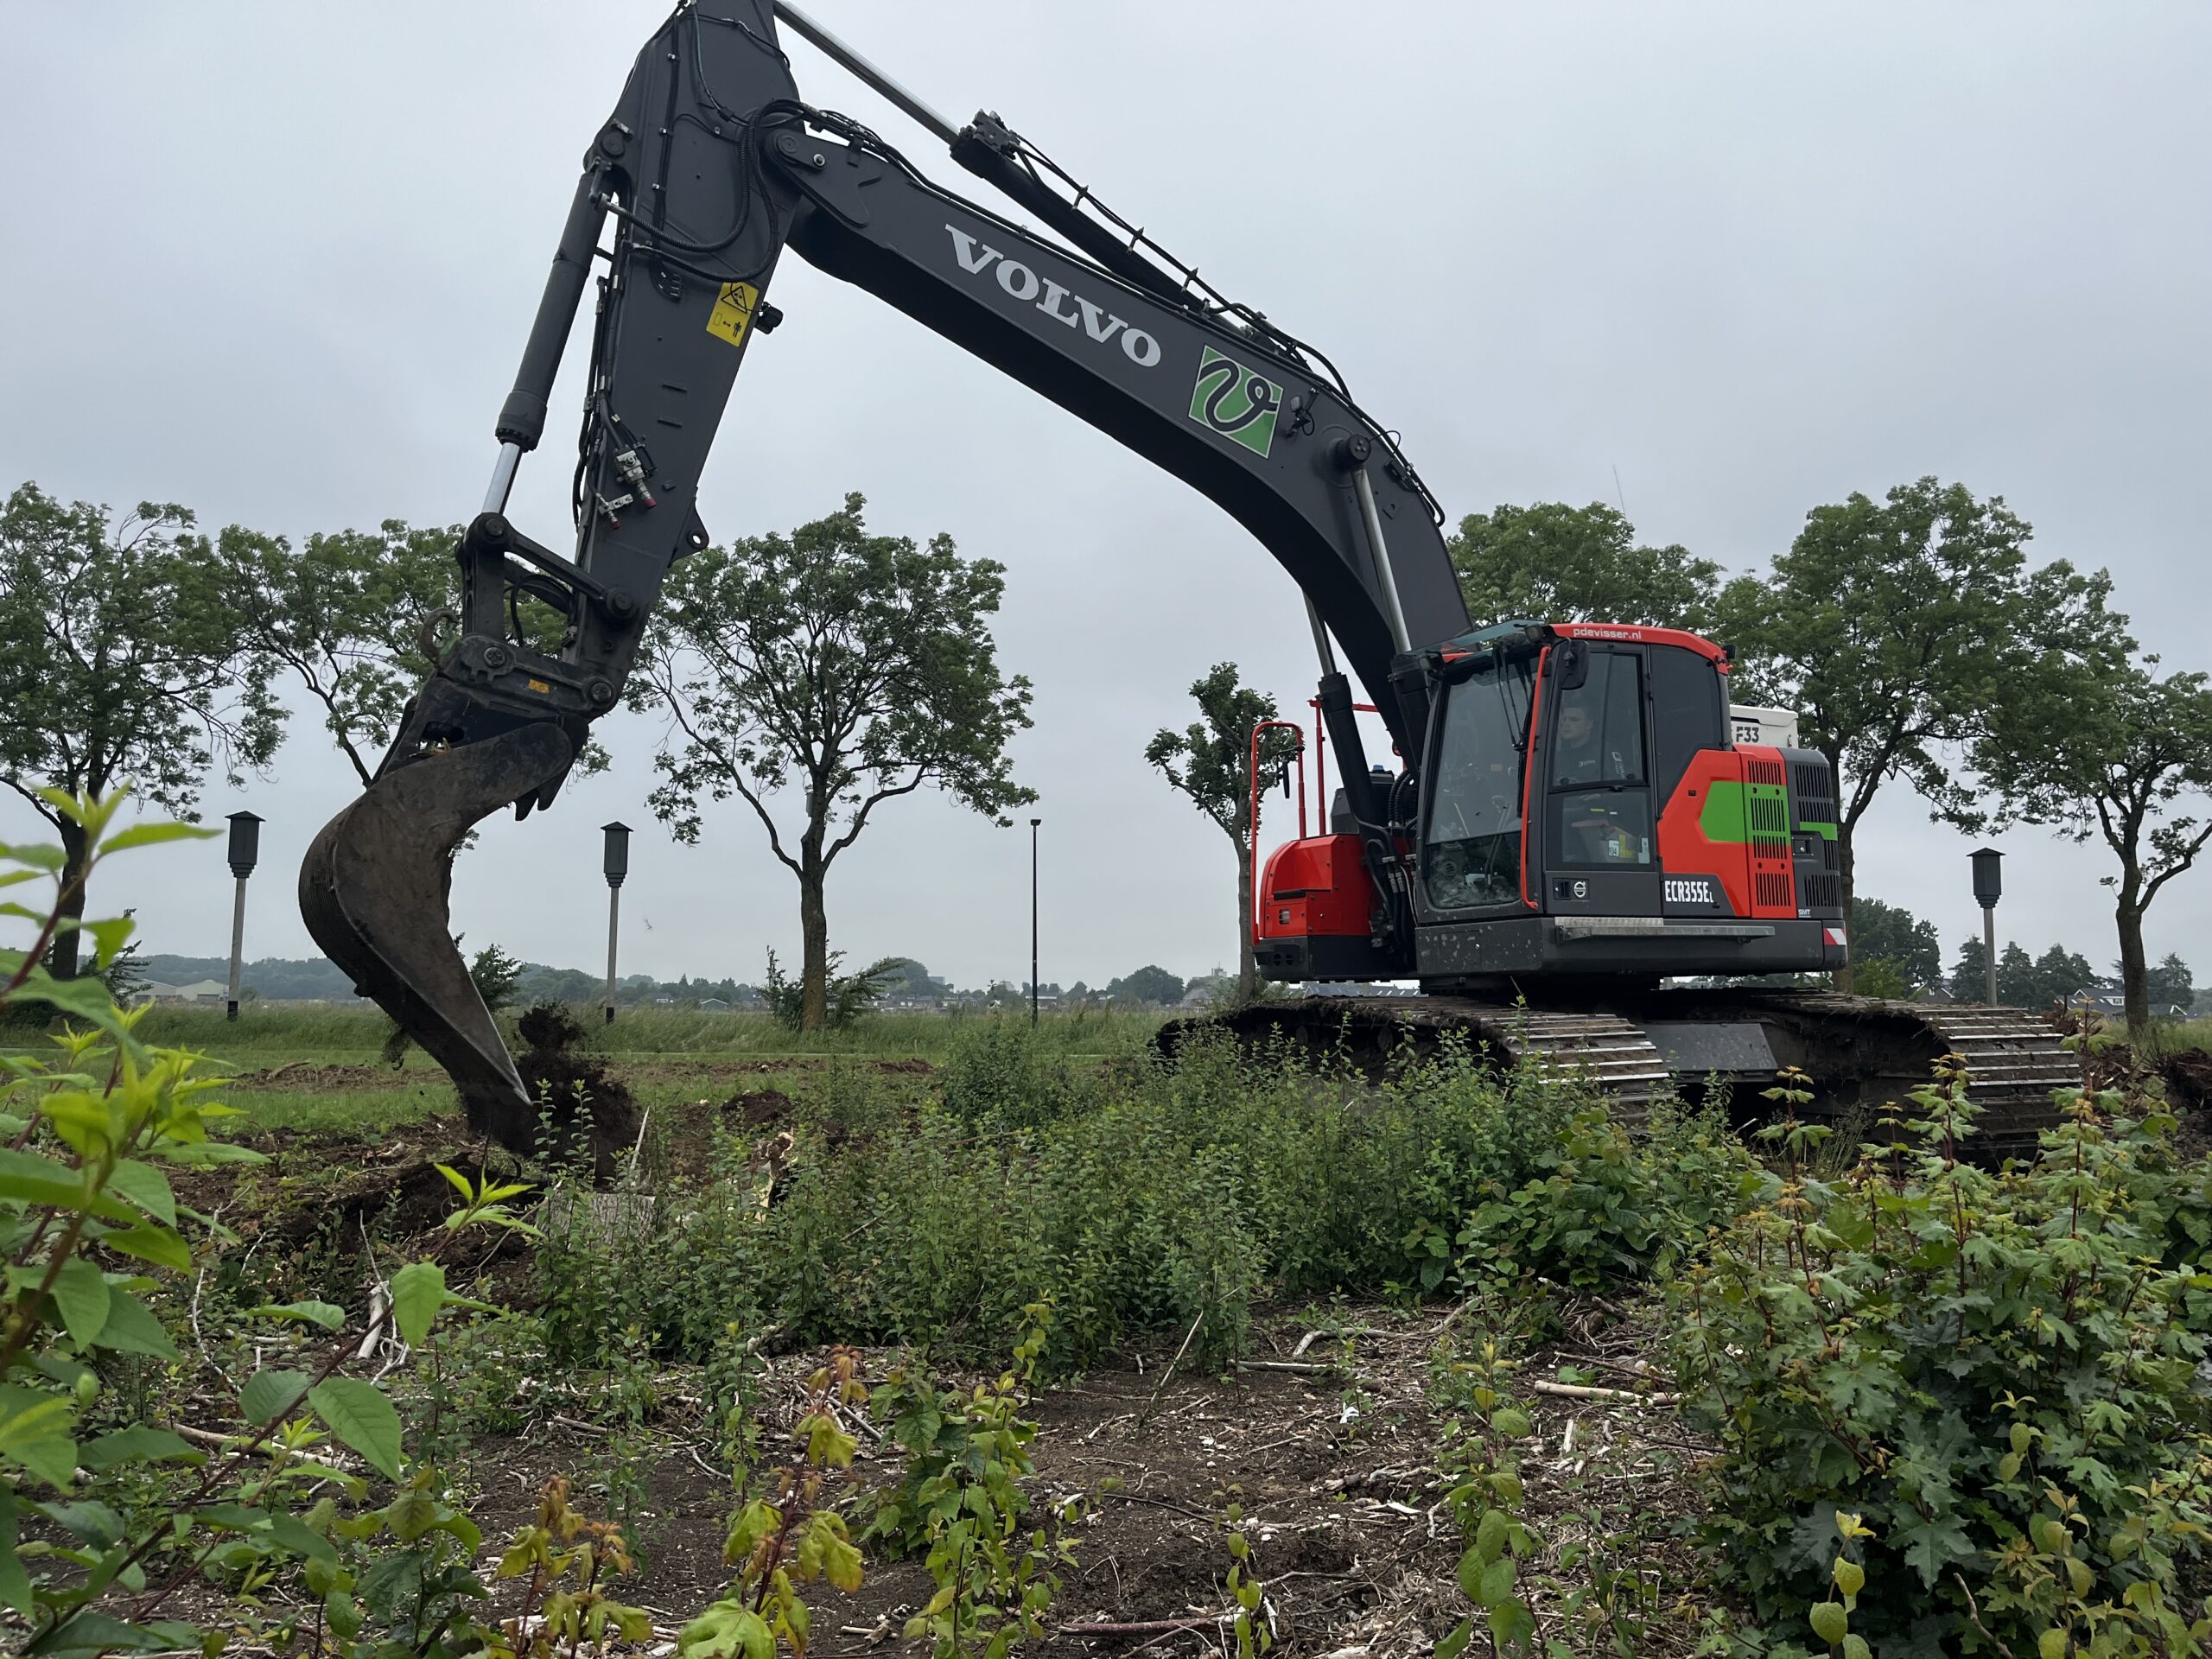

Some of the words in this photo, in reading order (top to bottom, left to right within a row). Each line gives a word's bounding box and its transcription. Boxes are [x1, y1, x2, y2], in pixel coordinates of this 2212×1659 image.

[945, 223, 1161, 367] VOLVO
[1573, 627, 1642, 639] pdevisser.nl
[1736, 726, 1759, 743] F33
